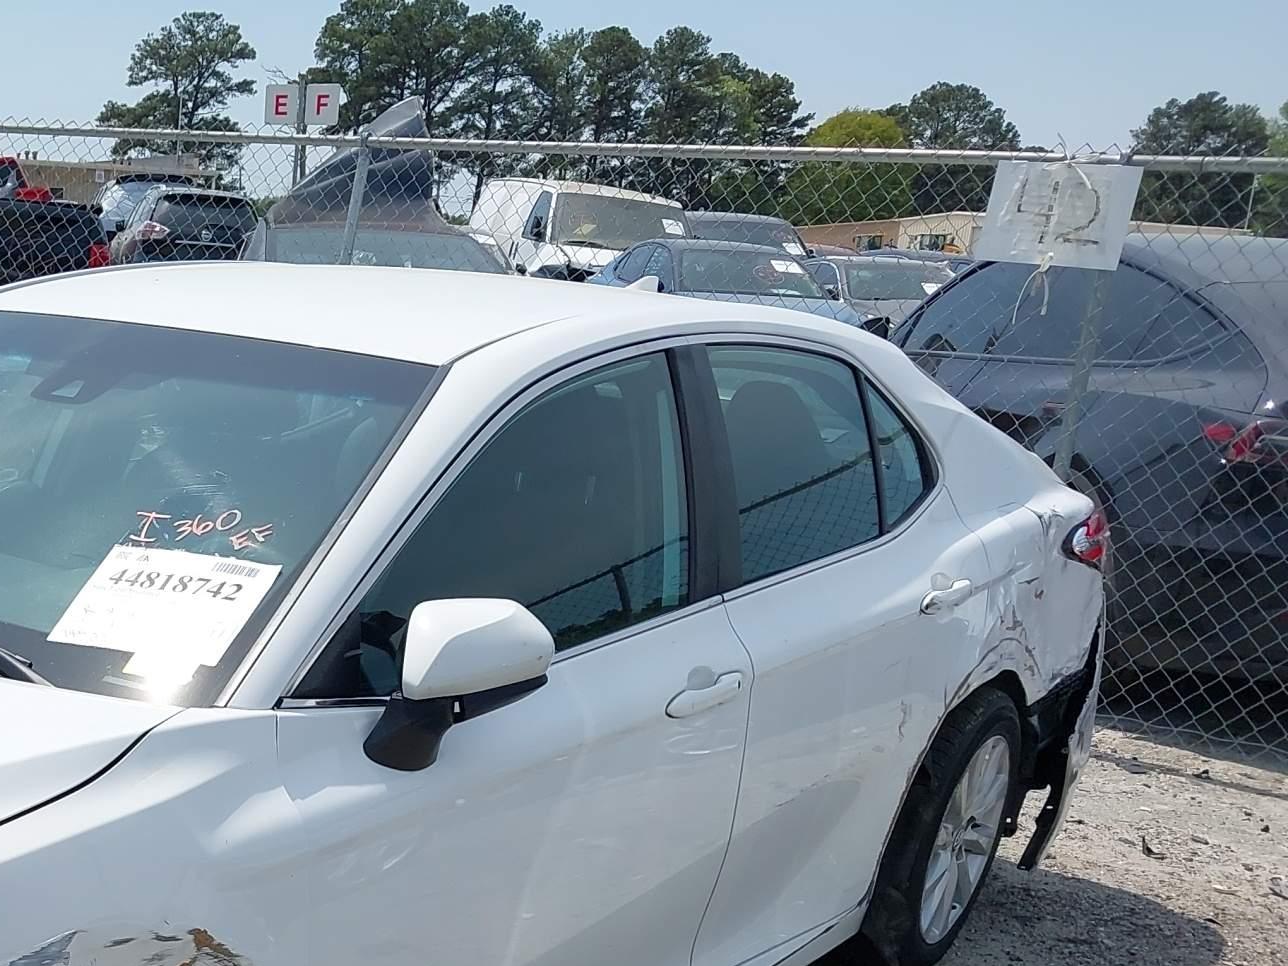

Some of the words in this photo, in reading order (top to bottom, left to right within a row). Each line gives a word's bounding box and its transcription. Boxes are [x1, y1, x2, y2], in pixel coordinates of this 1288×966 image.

[275, 95, 288, 115] E
[316, 95, 329, 115] F
[173, 509, 242, 541] 360
[228, 523, 275, 551] EF
[109, 568, 244, 601] 44818742
